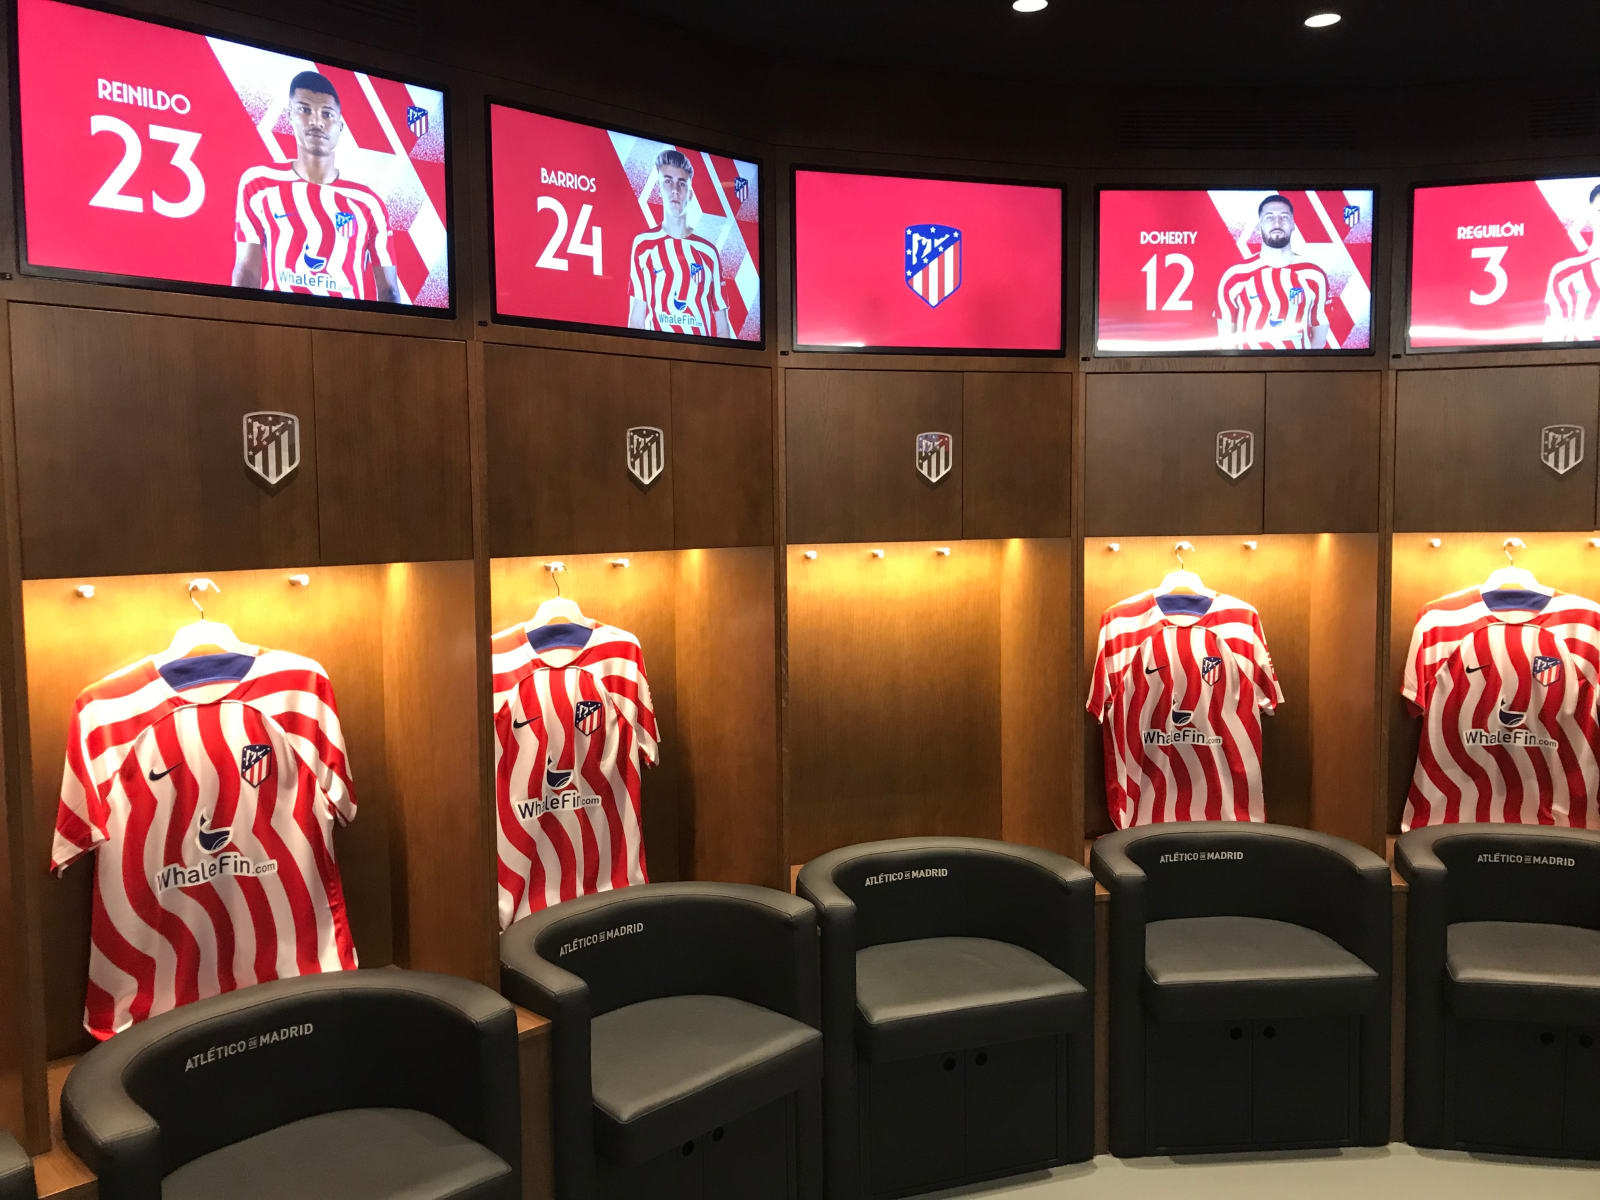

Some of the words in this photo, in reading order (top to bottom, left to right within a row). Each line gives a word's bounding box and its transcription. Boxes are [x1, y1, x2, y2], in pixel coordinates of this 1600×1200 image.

[97, 78, 191, 115] REINILDO
[88, 115, 206, 219] 23
[541, 167, 597, 193] BARRIOS
[535, 196, 603, 277] 24
[1140, 231, 1198, 245] DOHERTY
[1457, 221, 1524, 240] REGUILÓN
[1140, 253, 1195, 311] 12
[1469, 246, 1509, 306] 3
[156, 855, 276, 890] WhaleFin.com
[1160, 852, 1199, 863] ATLÉTICO
[1207, 851, 1244, 860] MADRID
[1477, 853, 1523, 864] ATLÉTICO
[1532, 856, 1576, 867] MADRID
[865, 872, 904, 887] ATLÉTICO
[911, 868, 949, 879] MADRID
[560, 934, 598, 957] ATLÉTICO
[606, 923, 644, 940] MADRID
[185, 1041, 246, 1072] ATLÉTICO
[259, 1023, 314, 1047] MADRID
